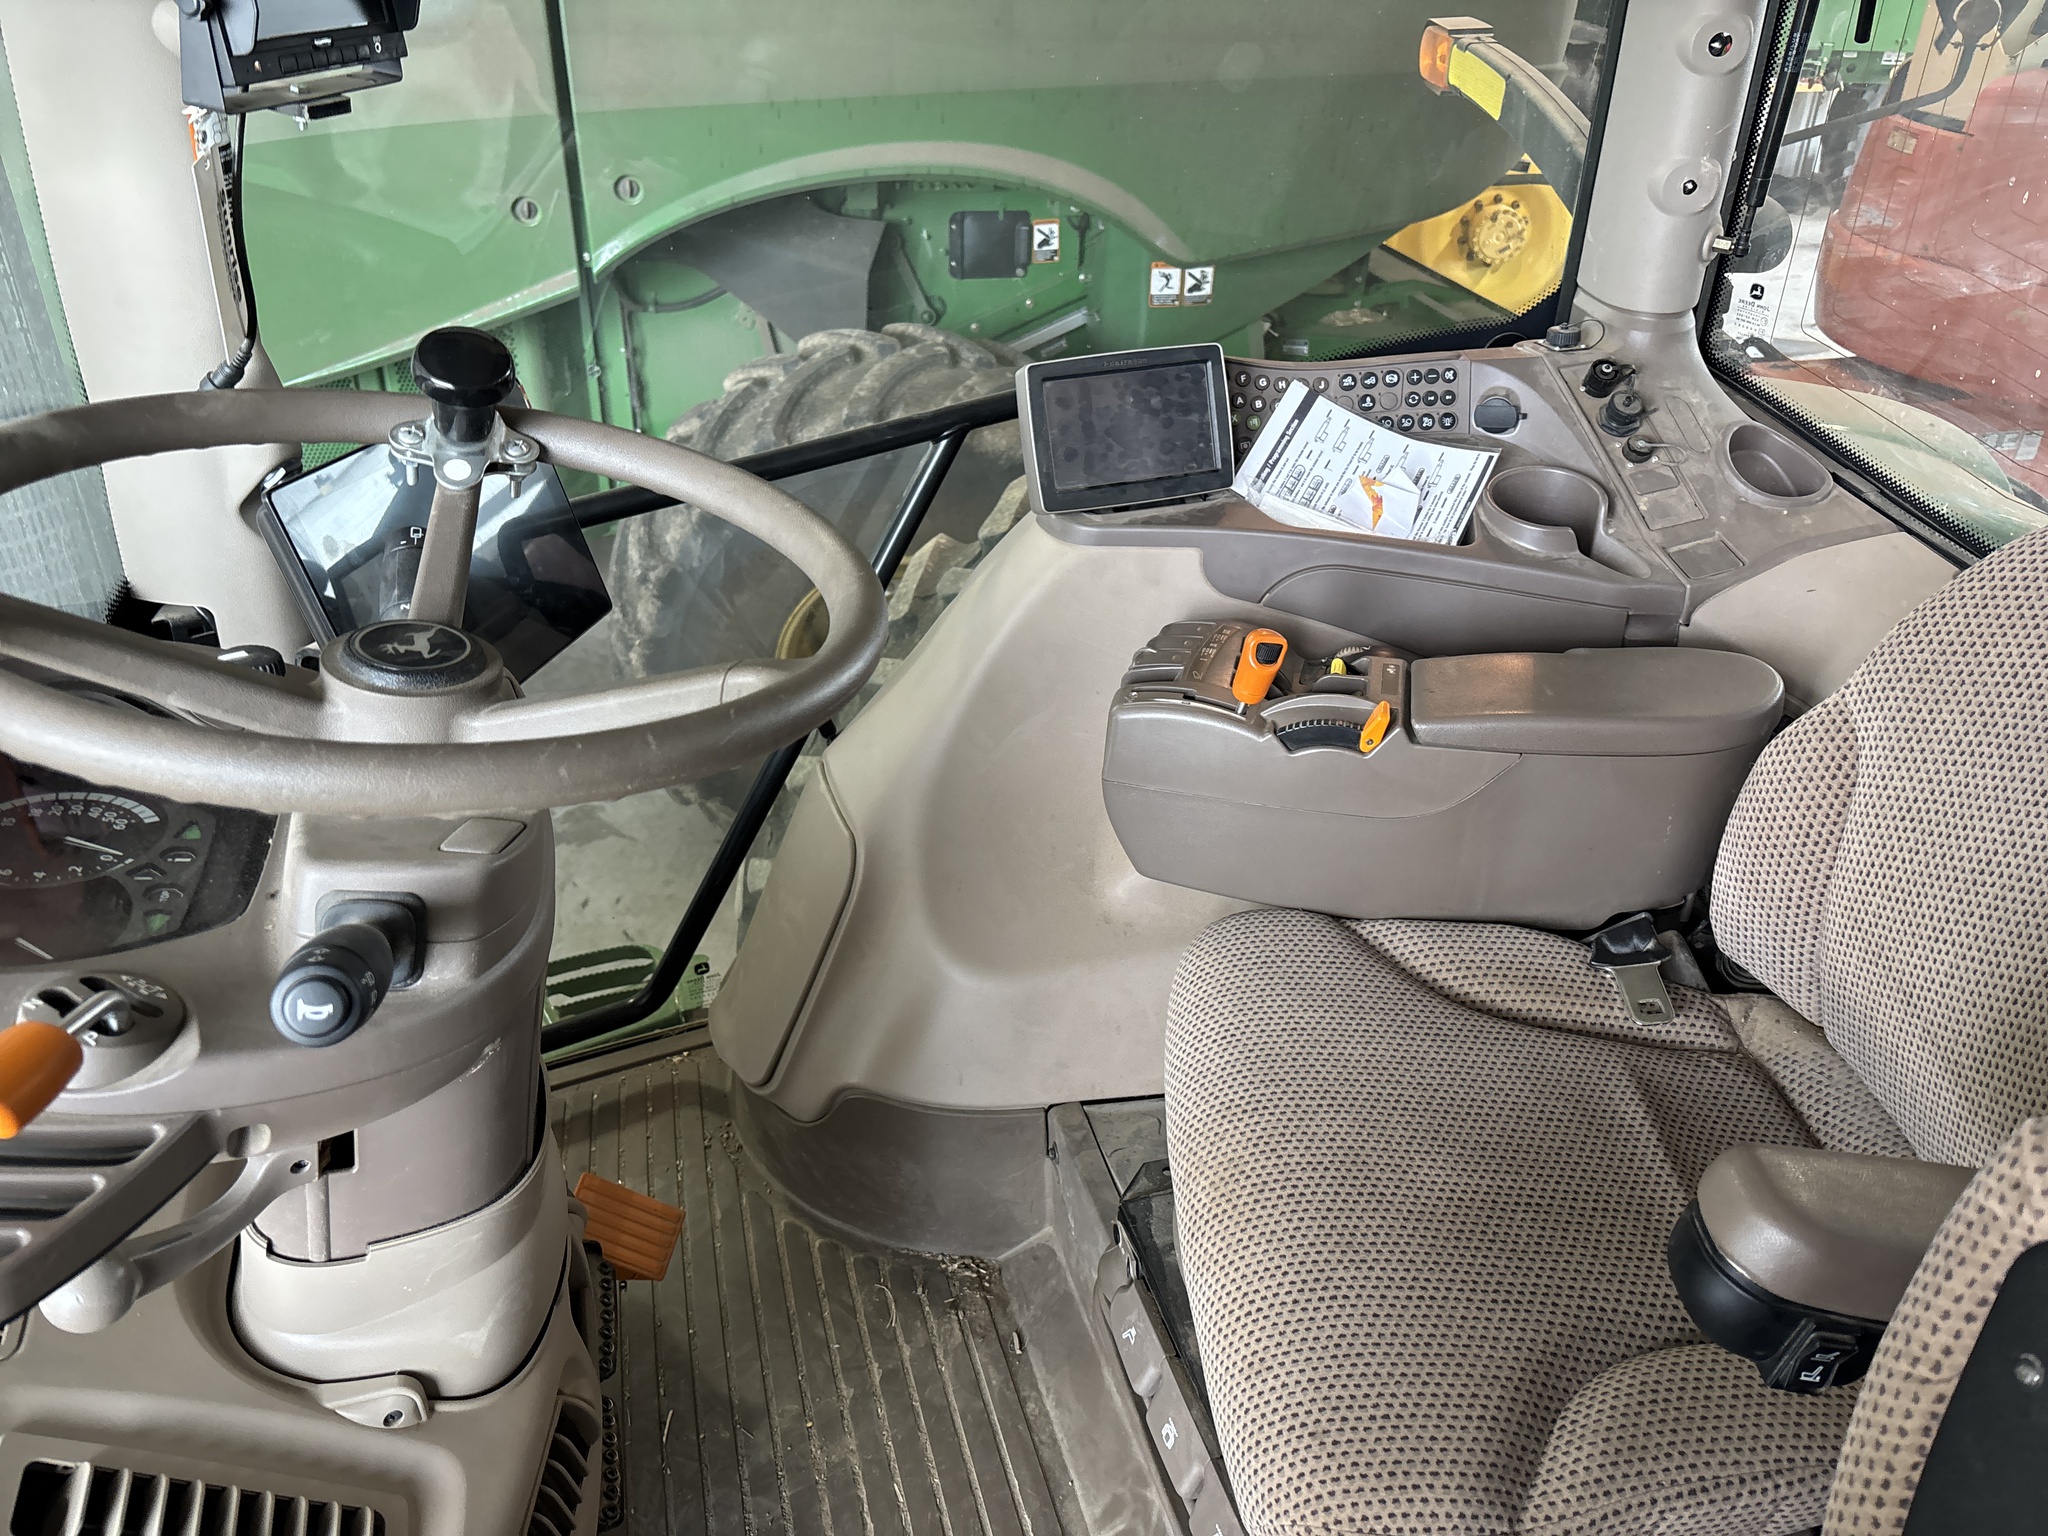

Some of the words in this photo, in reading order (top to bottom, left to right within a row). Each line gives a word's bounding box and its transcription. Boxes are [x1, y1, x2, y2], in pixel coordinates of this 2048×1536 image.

[1240, 374, 1246, 383] F
[1259, 378, 1267, 387] G
[1278, 380, 1286, 389] H
[1318, 380, 1325, 389] J
[1236, 396, 1244, 405] A
[1255, 400, 1263, 409] B
[1268, 433, 1290, 466] Programming
[1286, 418, 1300, 436] Section
[68, 804, 84, 815] 30
[88, 806, 103, 818] 40
[101, 811, 117, 822] 50
[112, 819, 128, 830] 60
[82, 1030, 99, 1046] P
